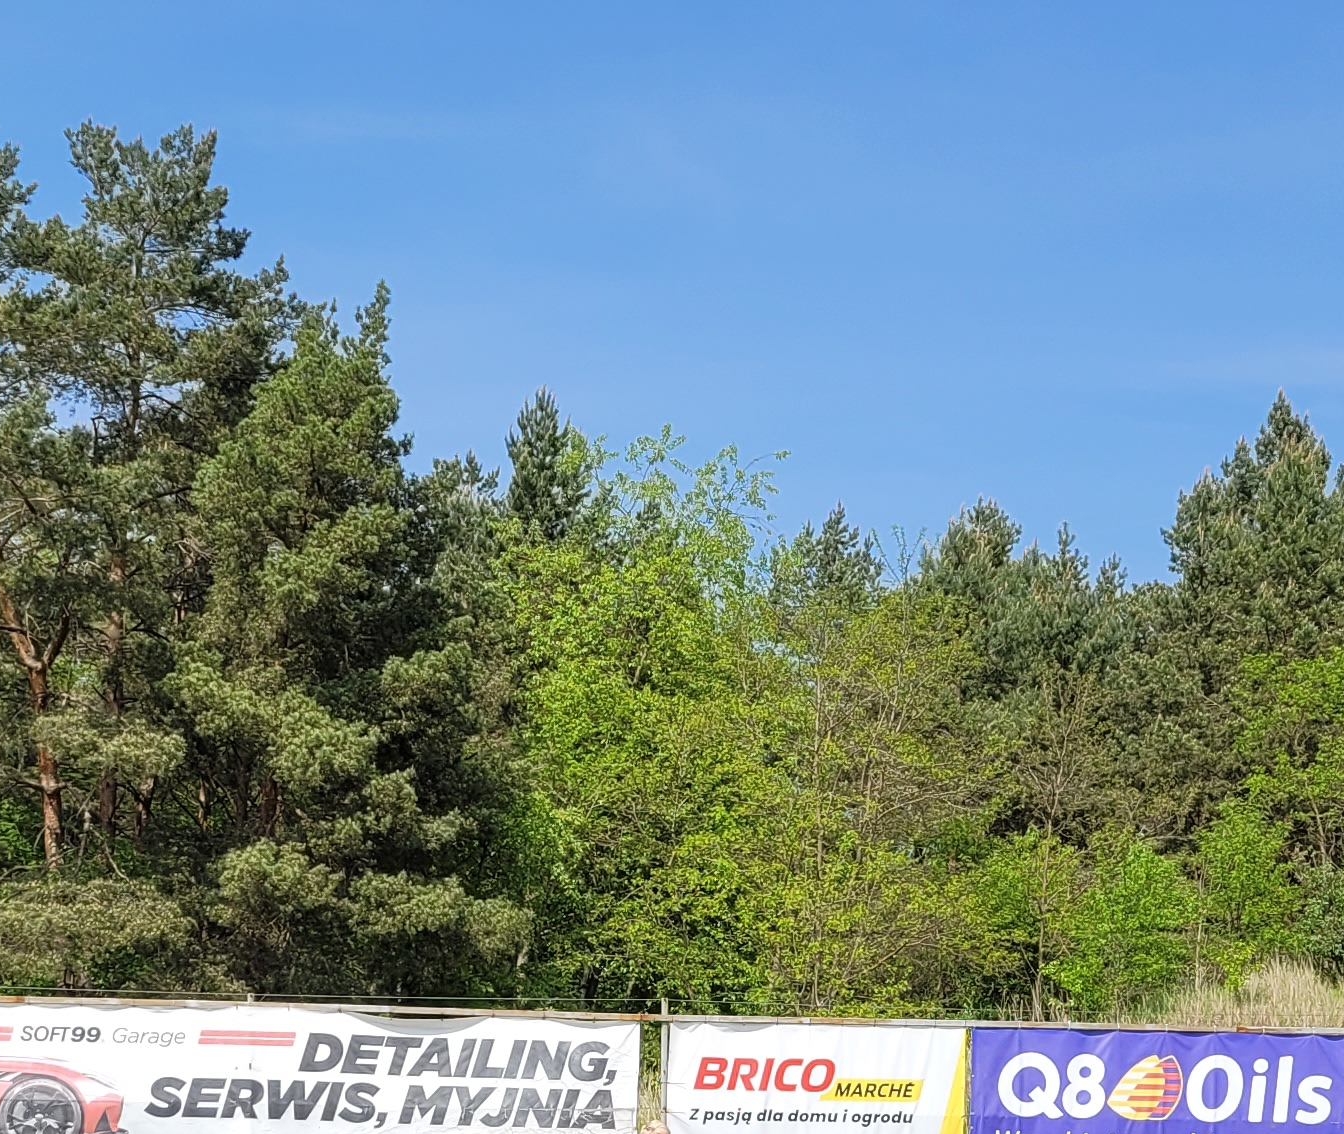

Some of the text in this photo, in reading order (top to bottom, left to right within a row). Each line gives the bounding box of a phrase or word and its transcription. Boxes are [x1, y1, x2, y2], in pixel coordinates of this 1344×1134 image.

[20, 1024, 186, 1047] SOFT99 Garage
[297, 1032, 618, 1086] DETAILING,
[693, 1057, 915, 1098] BRICO MARCHÉ
[997, 1052, 1333, 1125] Q8 Oils
[146, 1076, 618, 1130] SERWIS, MYJNIA
[689, 1108, 914, 1127] Z pasją dla domu i ogrodu
